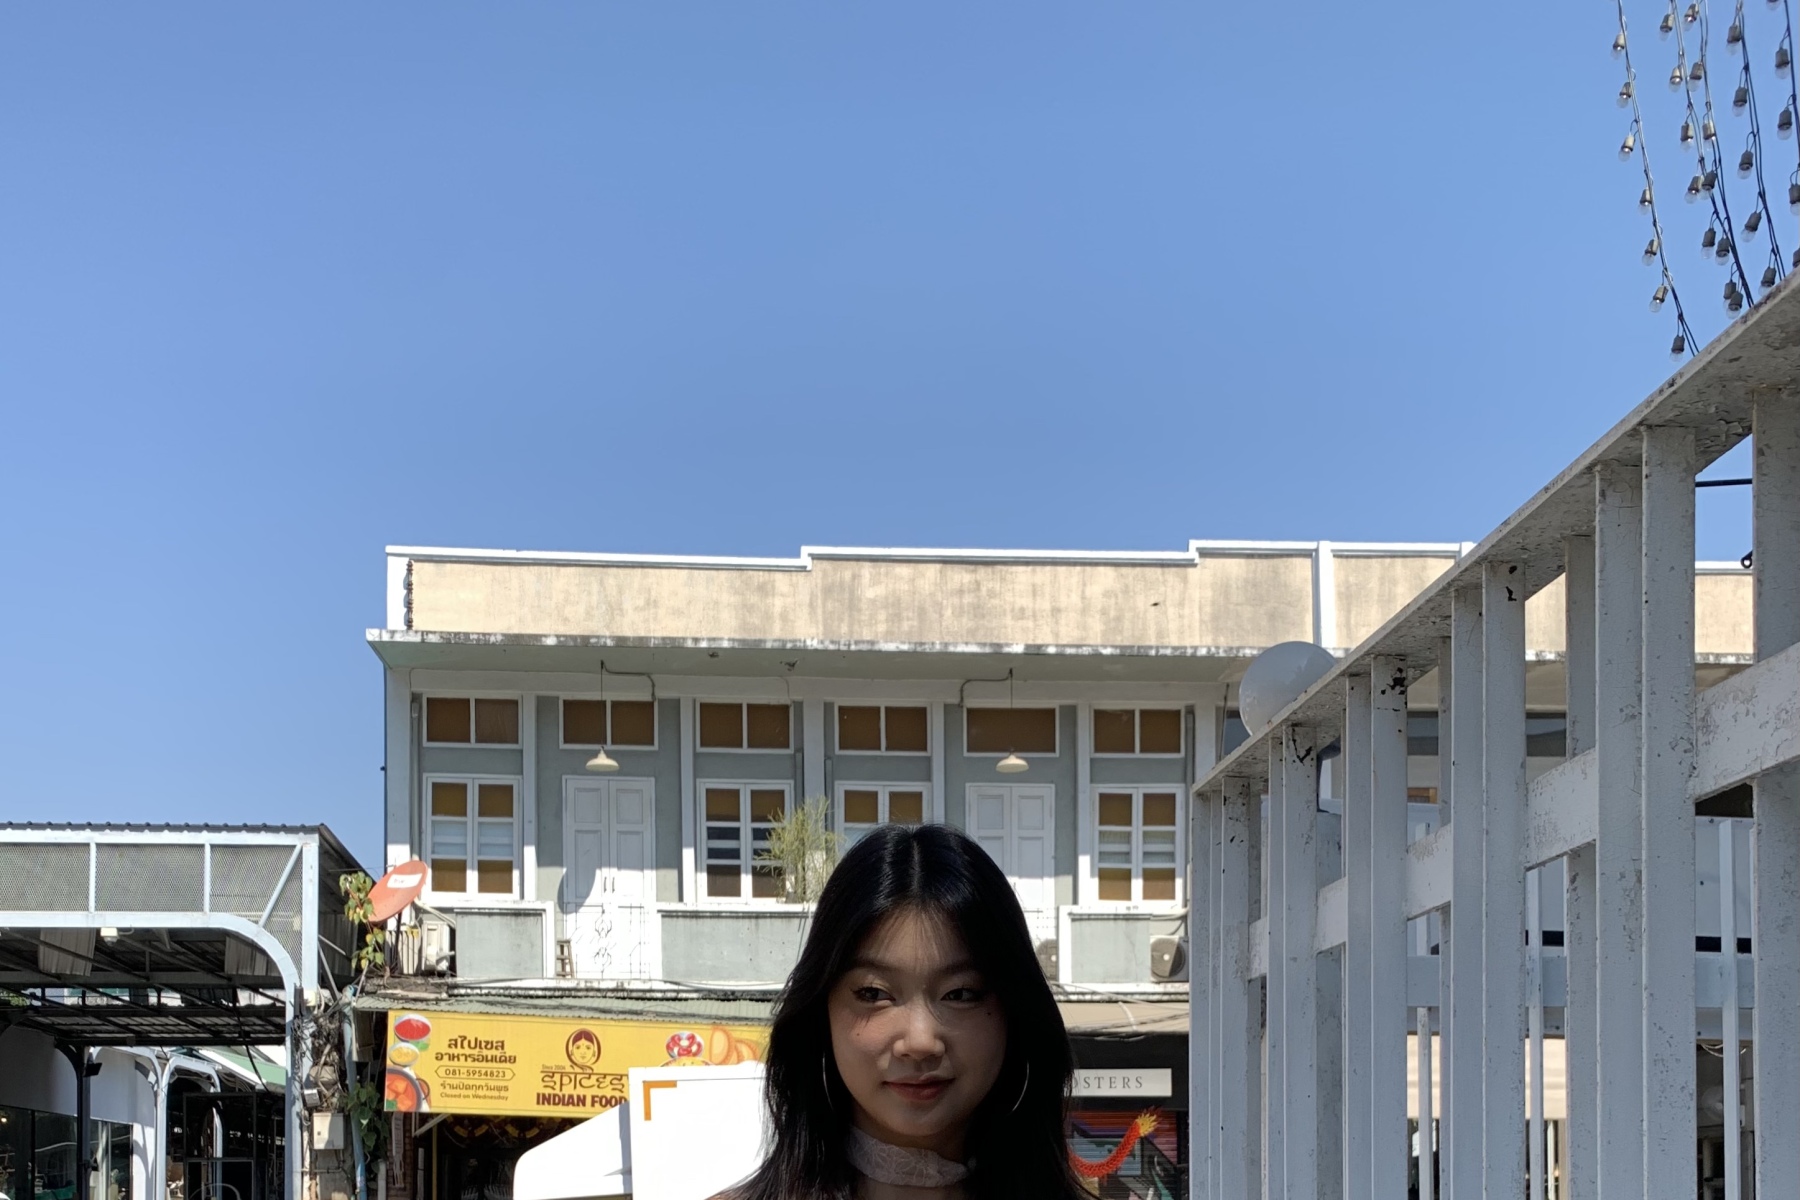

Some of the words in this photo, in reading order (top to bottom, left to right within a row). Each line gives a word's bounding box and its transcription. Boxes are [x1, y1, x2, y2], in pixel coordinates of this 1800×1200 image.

[435, 1051, 517, 1064] อาหารอินเดีย
[444, 1068, 506, 1078] 081-5954823
[471, 1092, 509, 1101] Wednesday
[536, 1093, 587, 1107] INDIAN
